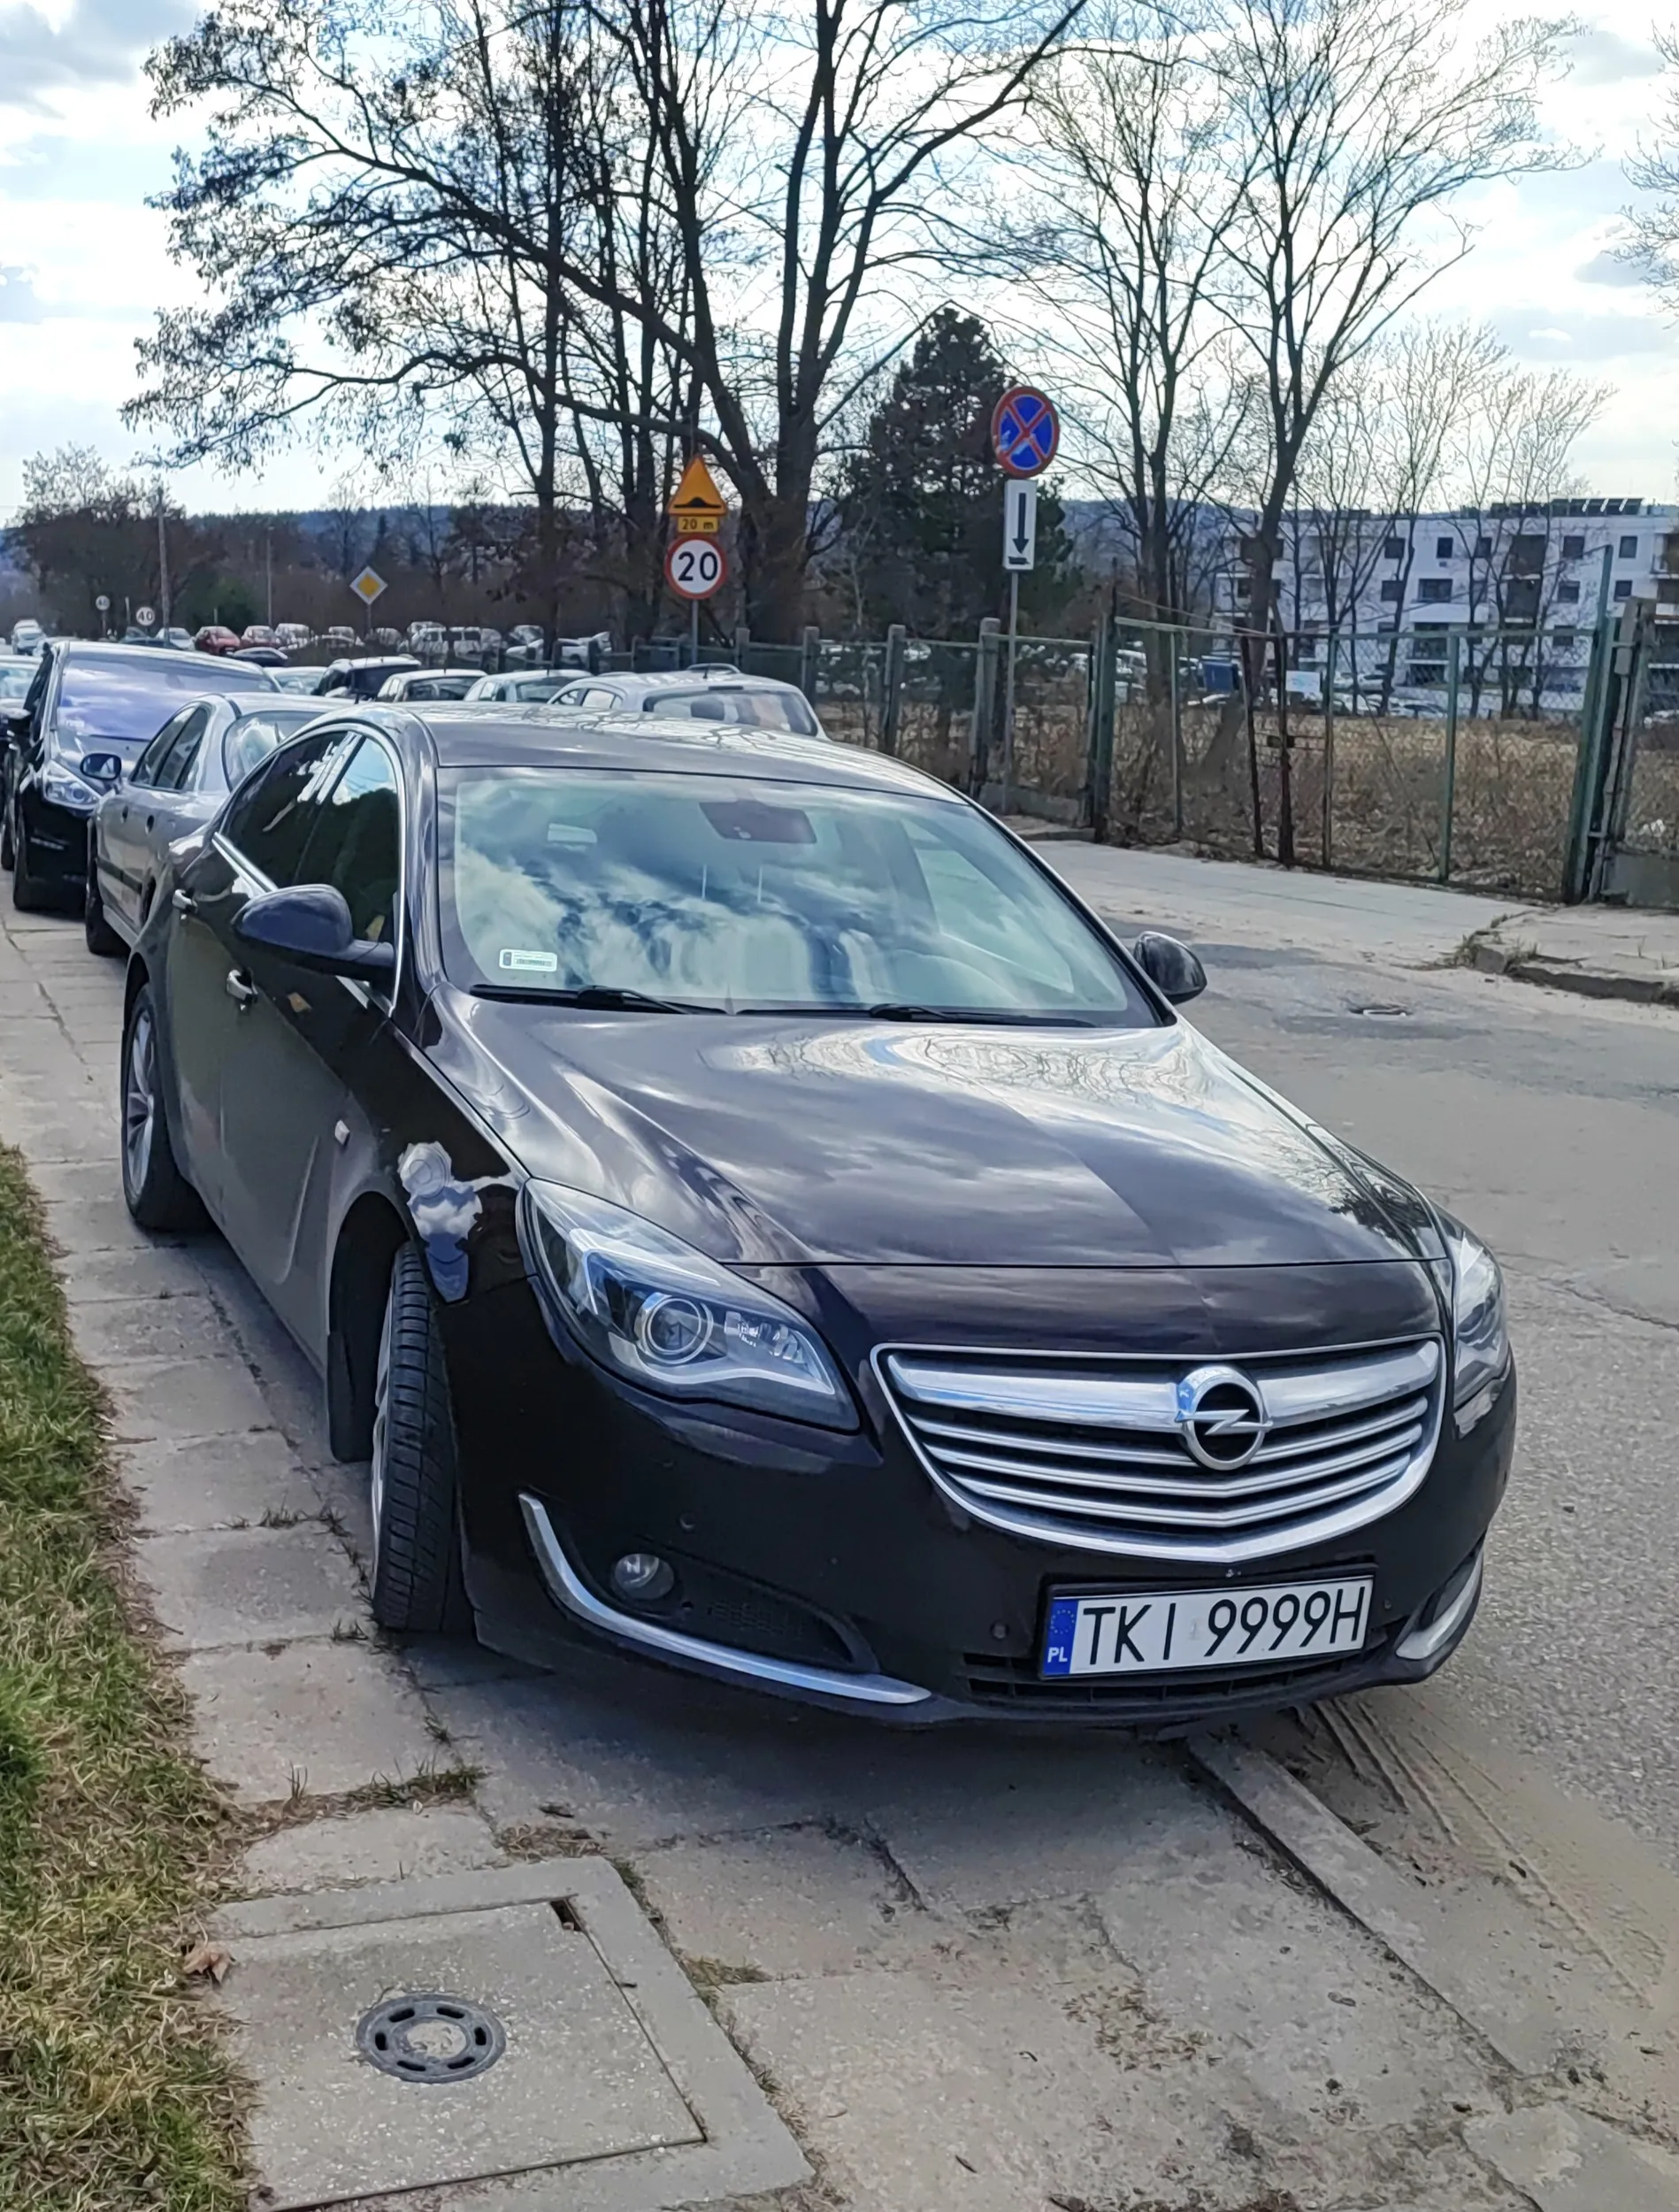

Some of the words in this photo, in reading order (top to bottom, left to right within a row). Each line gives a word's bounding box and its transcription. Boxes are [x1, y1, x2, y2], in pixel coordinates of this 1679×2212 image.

[682, 518, 698, 530] 20
[702, 521, 714, 530] m
[678, 551, 718, 581] 20
[137, 611, 153, 621] 40
[1083, 1602, 1177, 1665] TKI
[1203, 1586, 1366, 1657] 9999H
[1047, 1647, 1068, 1663] PL
